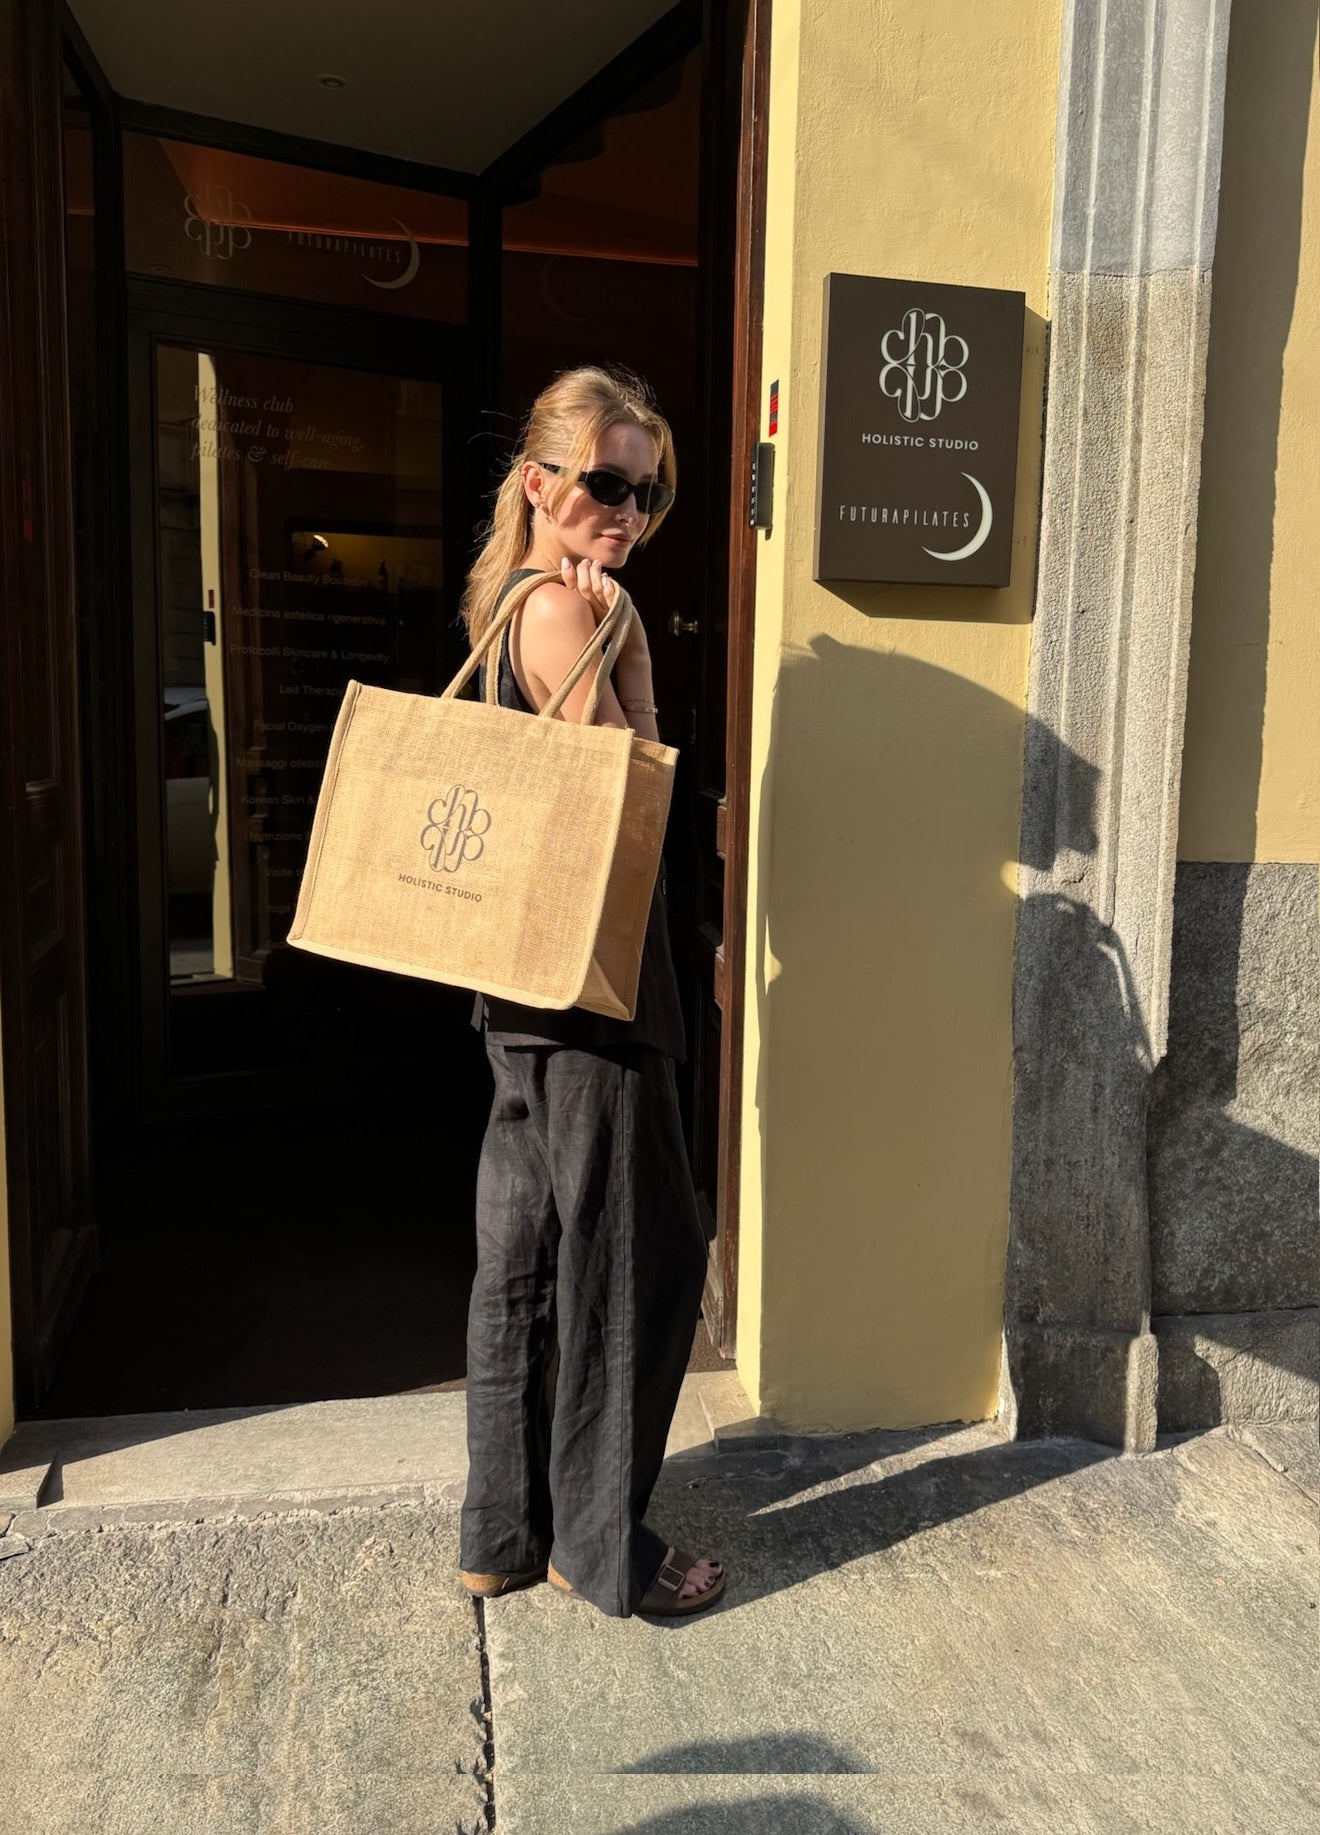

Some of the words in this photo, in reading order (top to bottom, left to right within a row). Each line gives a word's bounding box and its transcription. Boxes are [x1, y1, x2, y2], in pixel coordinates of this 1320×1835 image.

[263, 395, 294, 414] club
[266, 424, 280, 438] to
[861, 432, 925, 447] HOLISTIC
[929, 437, 979, 451] STUDIO
[247, 446, 266, 462] &
[839, 505, 970, 528] FUTURAPILATES
[249, 569, 281, 581] Clean
[283, 572, 320, 586] Beauty
[232, 606, 280, 619] Medicina
[283, 609, 324, 622] estetica
[230, 644, 280, 656] Protocolli
[282, 646, 327, 659] Skincare
[330, 651, 338, 659] &
[341, 650, 389, 664] Longevity
[280, 685, 299, 695] Led
[254, 721, 285, 732] Facial
[288, 721, 328, 734] Oxygen
[236, 757, 288, 770] Massaggi
[241, 794, 279, 805] Korean
[281, 794, 305, 805] Skin
[398, 873, 443, 893] HOLISTIC
[445, 886, 483, 903] STUDIO
